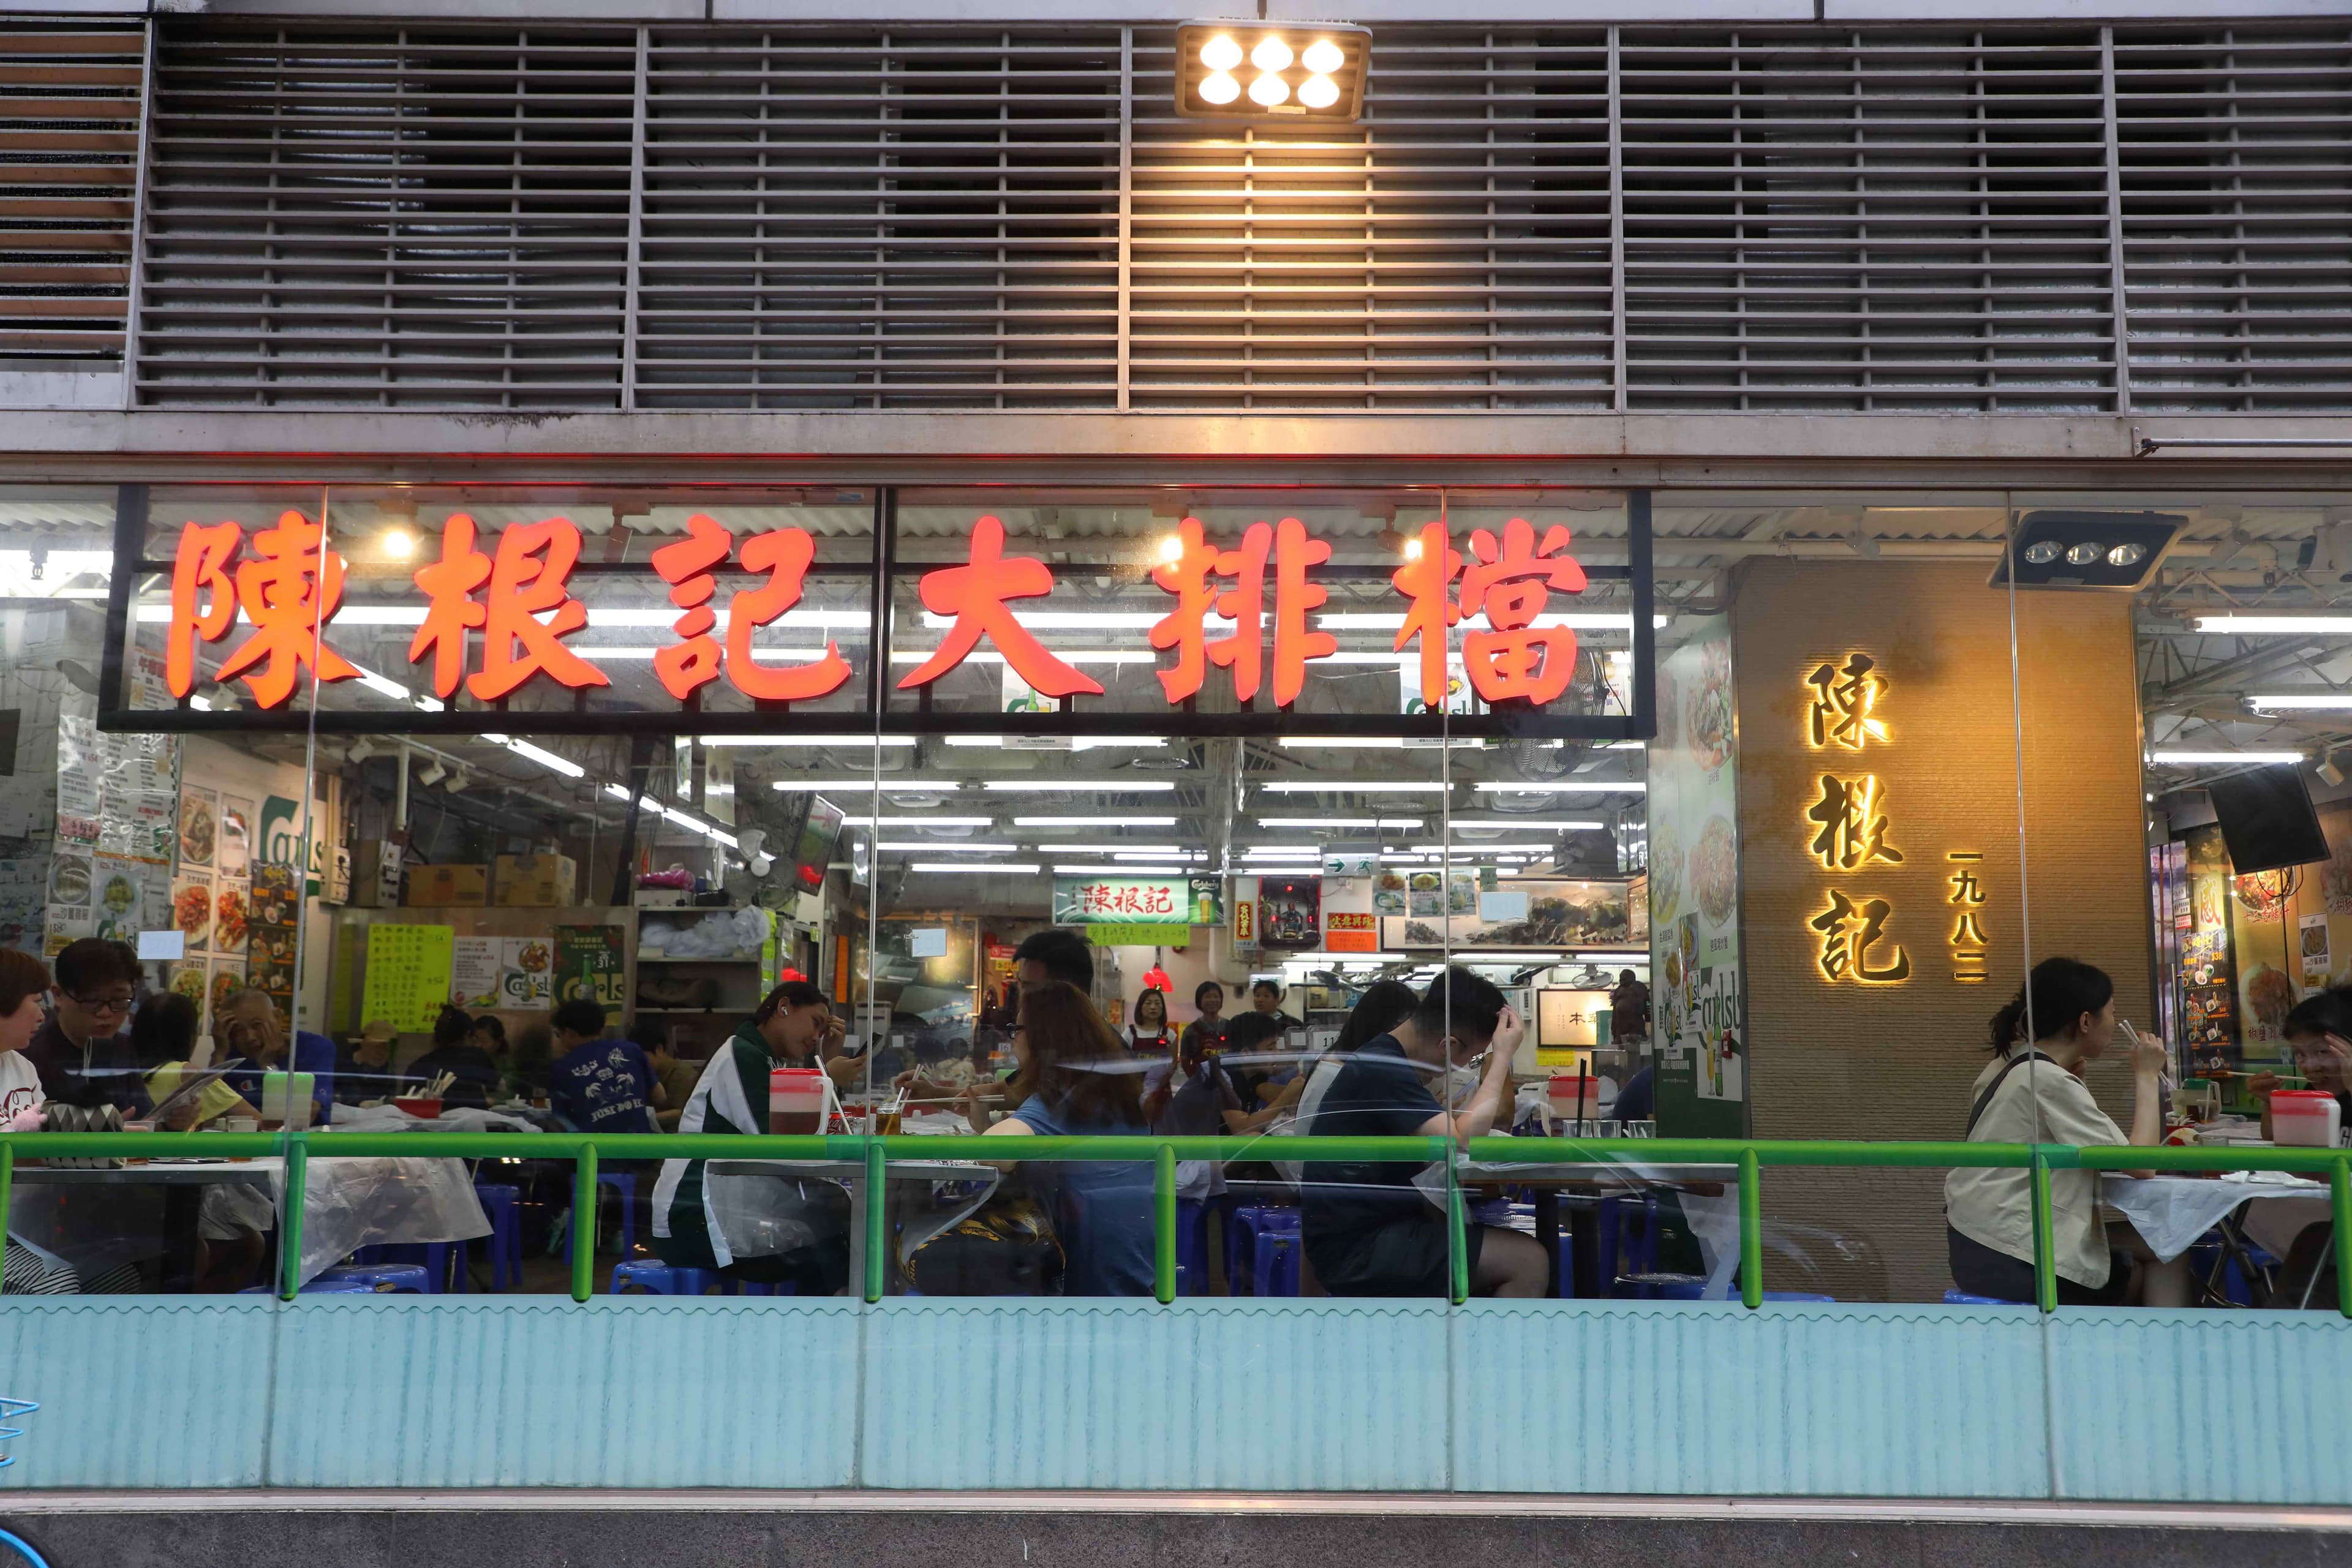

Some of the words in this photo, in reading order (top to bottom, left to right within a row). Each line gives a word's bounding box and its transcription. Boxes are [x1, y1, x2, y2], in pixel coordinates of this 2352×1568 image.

[167, 510, 1588, 709] 陳根記大排檔
[1080, 883, 1174, 915] 陳根記
[1807, 653, 1910, 982] 陳根記
[1949, 853, 1988, 980] 一九八二
